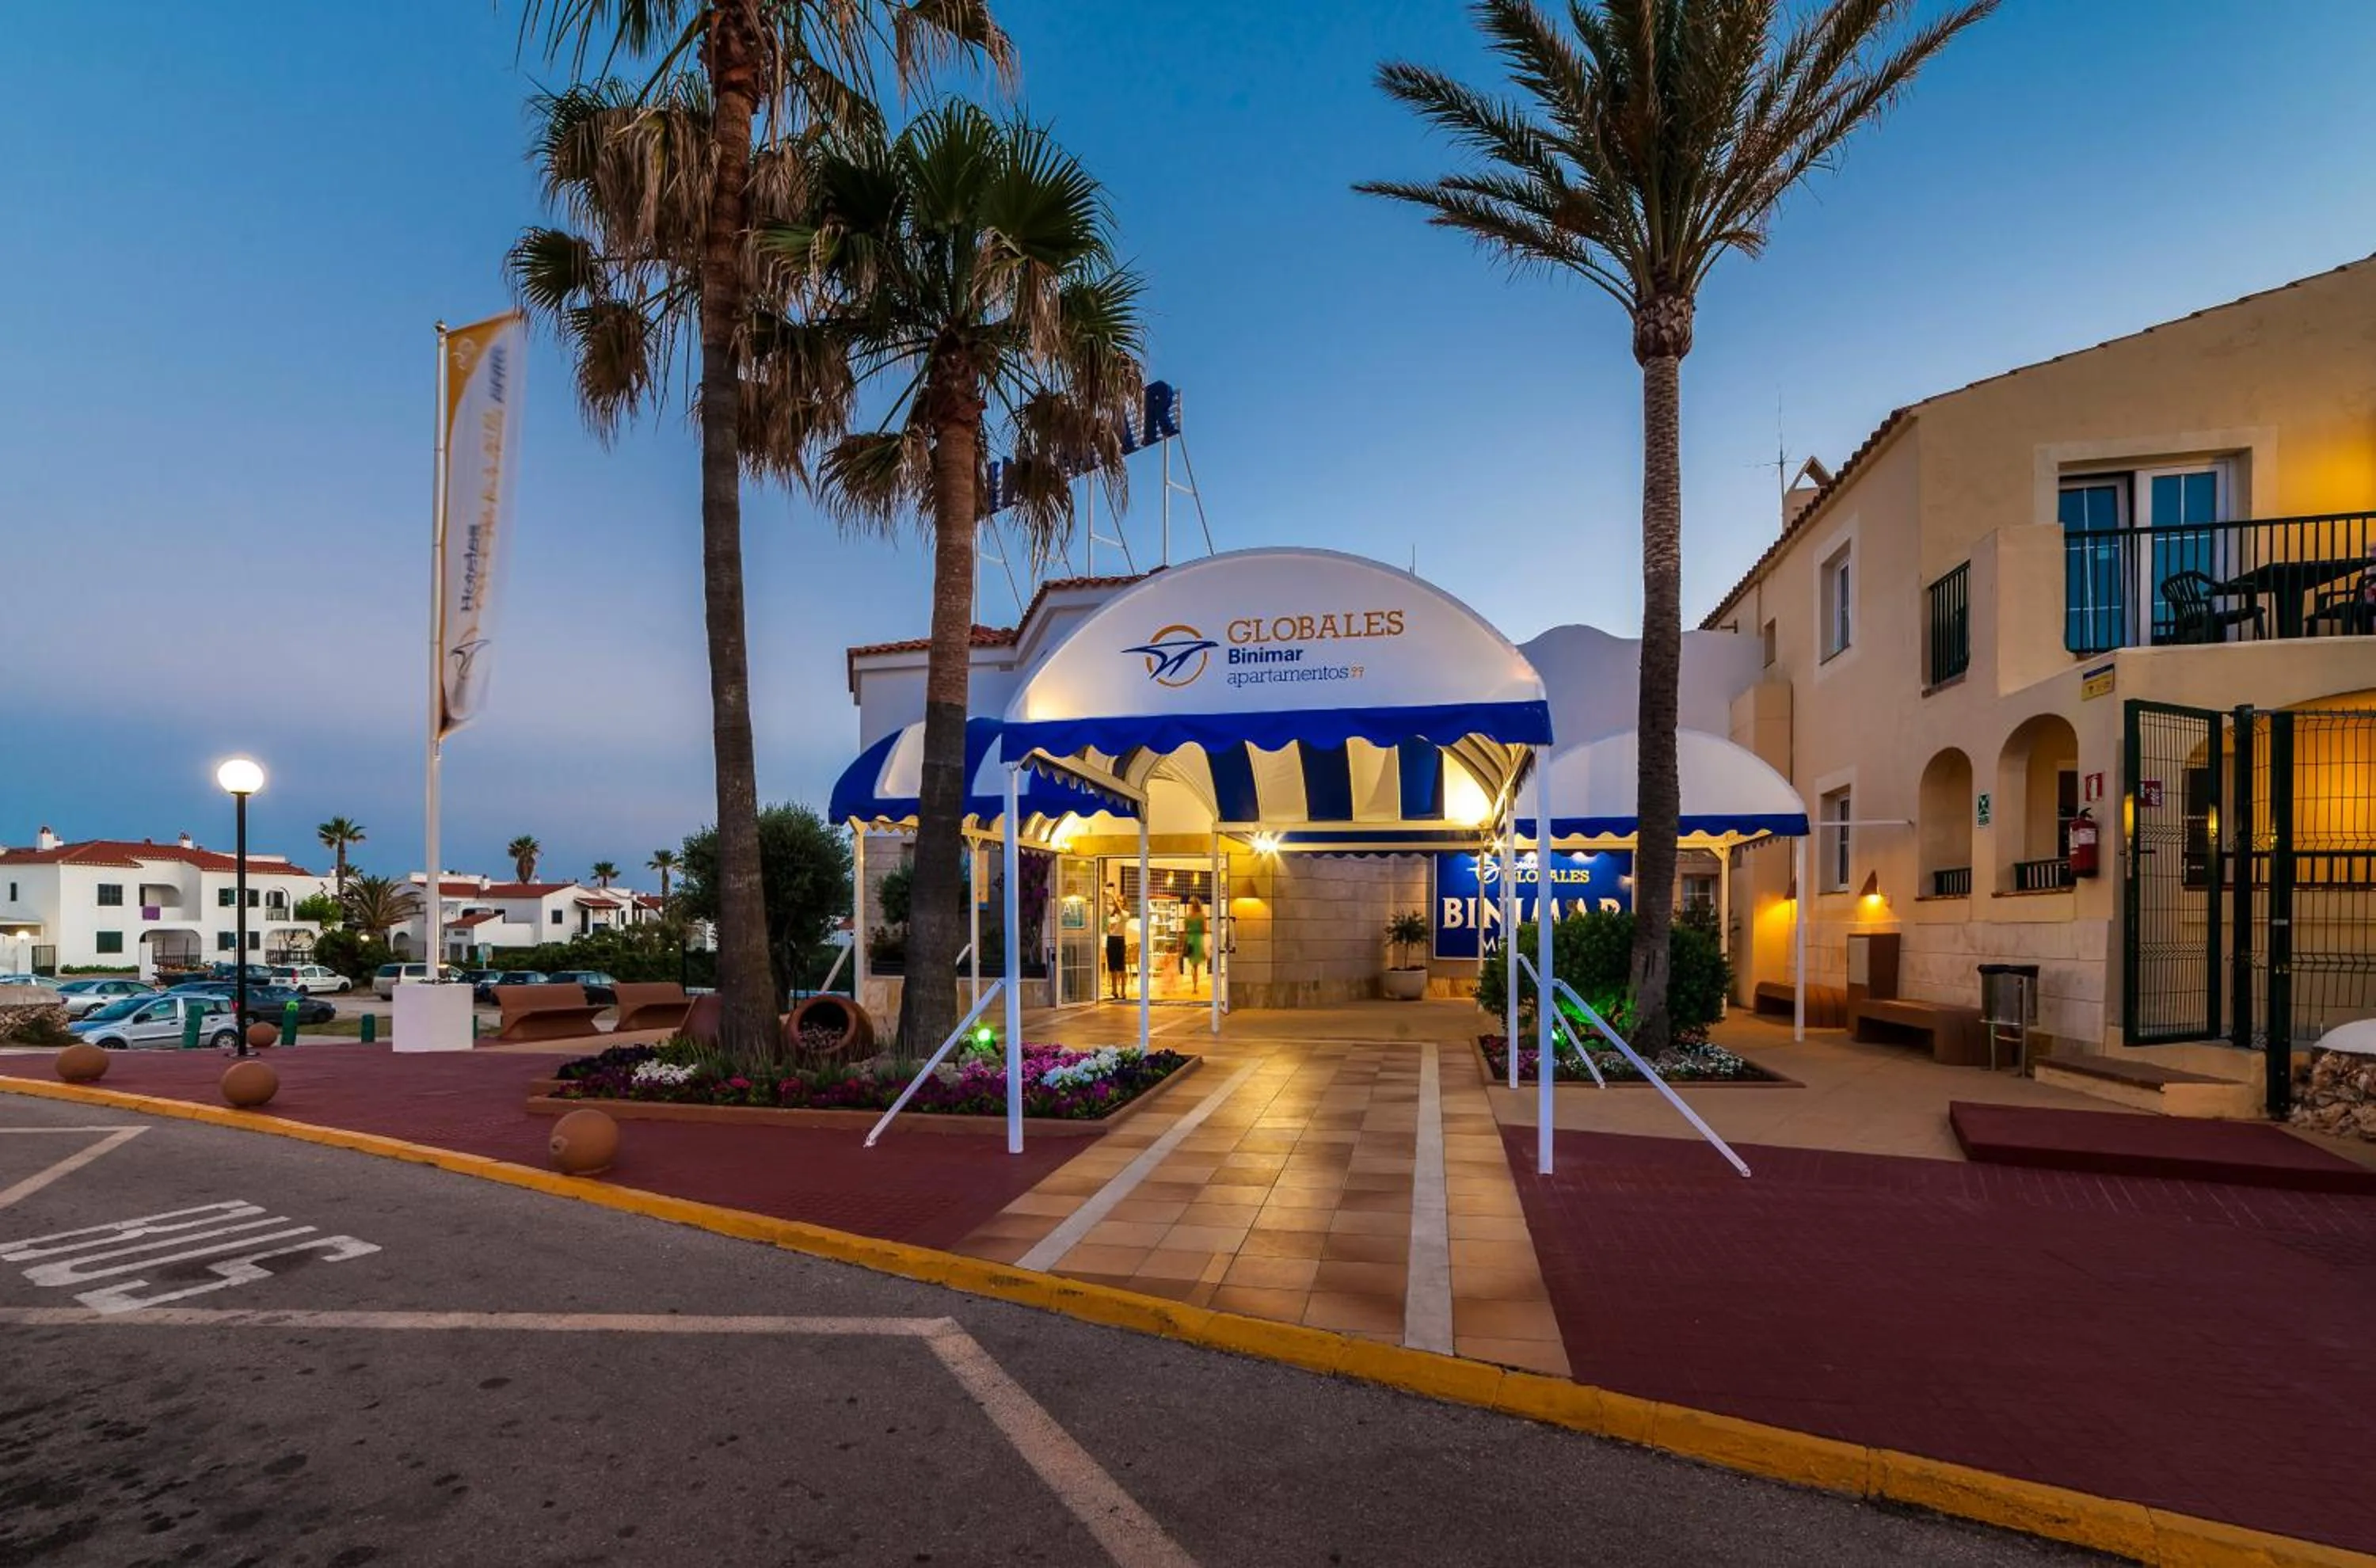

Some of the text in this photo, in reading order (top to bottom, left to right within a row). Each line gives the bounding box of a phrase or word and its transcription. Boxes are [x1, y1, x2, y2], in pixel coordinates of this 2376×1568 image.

[1228, 611, 1404, 644] GLOBALES
[1228, 647, 1304, 664] Binimar
[1227, 665, 1350, 688] apartamentos
[1506, 870, 1590, 884] LOALES
[0, 1200, 382, 1315] BUS
